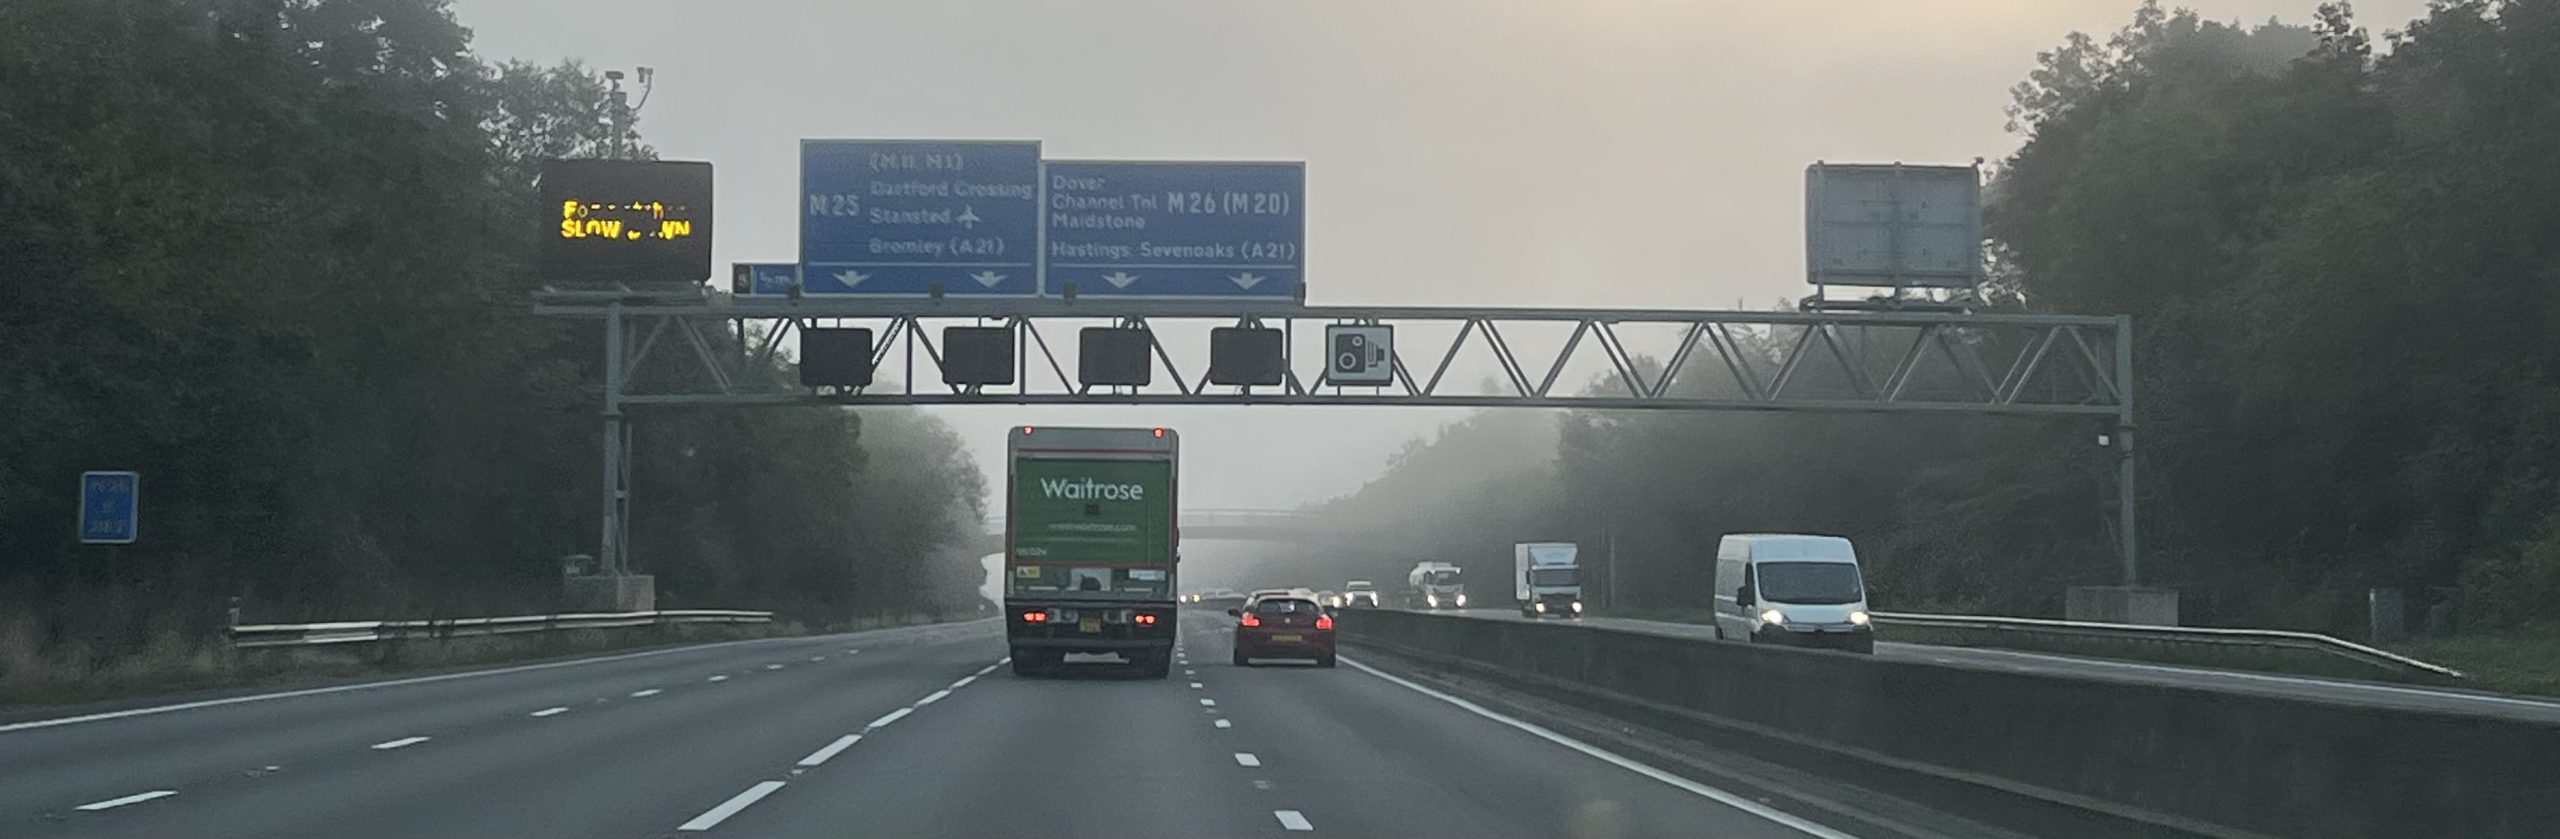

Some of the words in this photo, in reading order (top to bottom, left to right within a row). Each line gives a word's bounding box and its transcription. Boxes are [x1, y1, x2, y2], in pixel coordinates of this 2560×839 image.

[870, 181, 949, 198] Dartford
[954, 181, 1034, 200] Crossing
[1053, 175, 1106, 191] Dover
[1052, 193, 1125, 210] Channel
[1131, 193, 1157, 210] Tnl
[869, 208, 952, 224] Stansted
[1052, 213, 1146, 229] Maidstone
[561, 219, 623, 239] SLOW
[869, 238, 945, 257] Bromley
[1140, 241, 1235, 259] Sevenoaks
[1041, 477, 1144, 501] Waitrose
